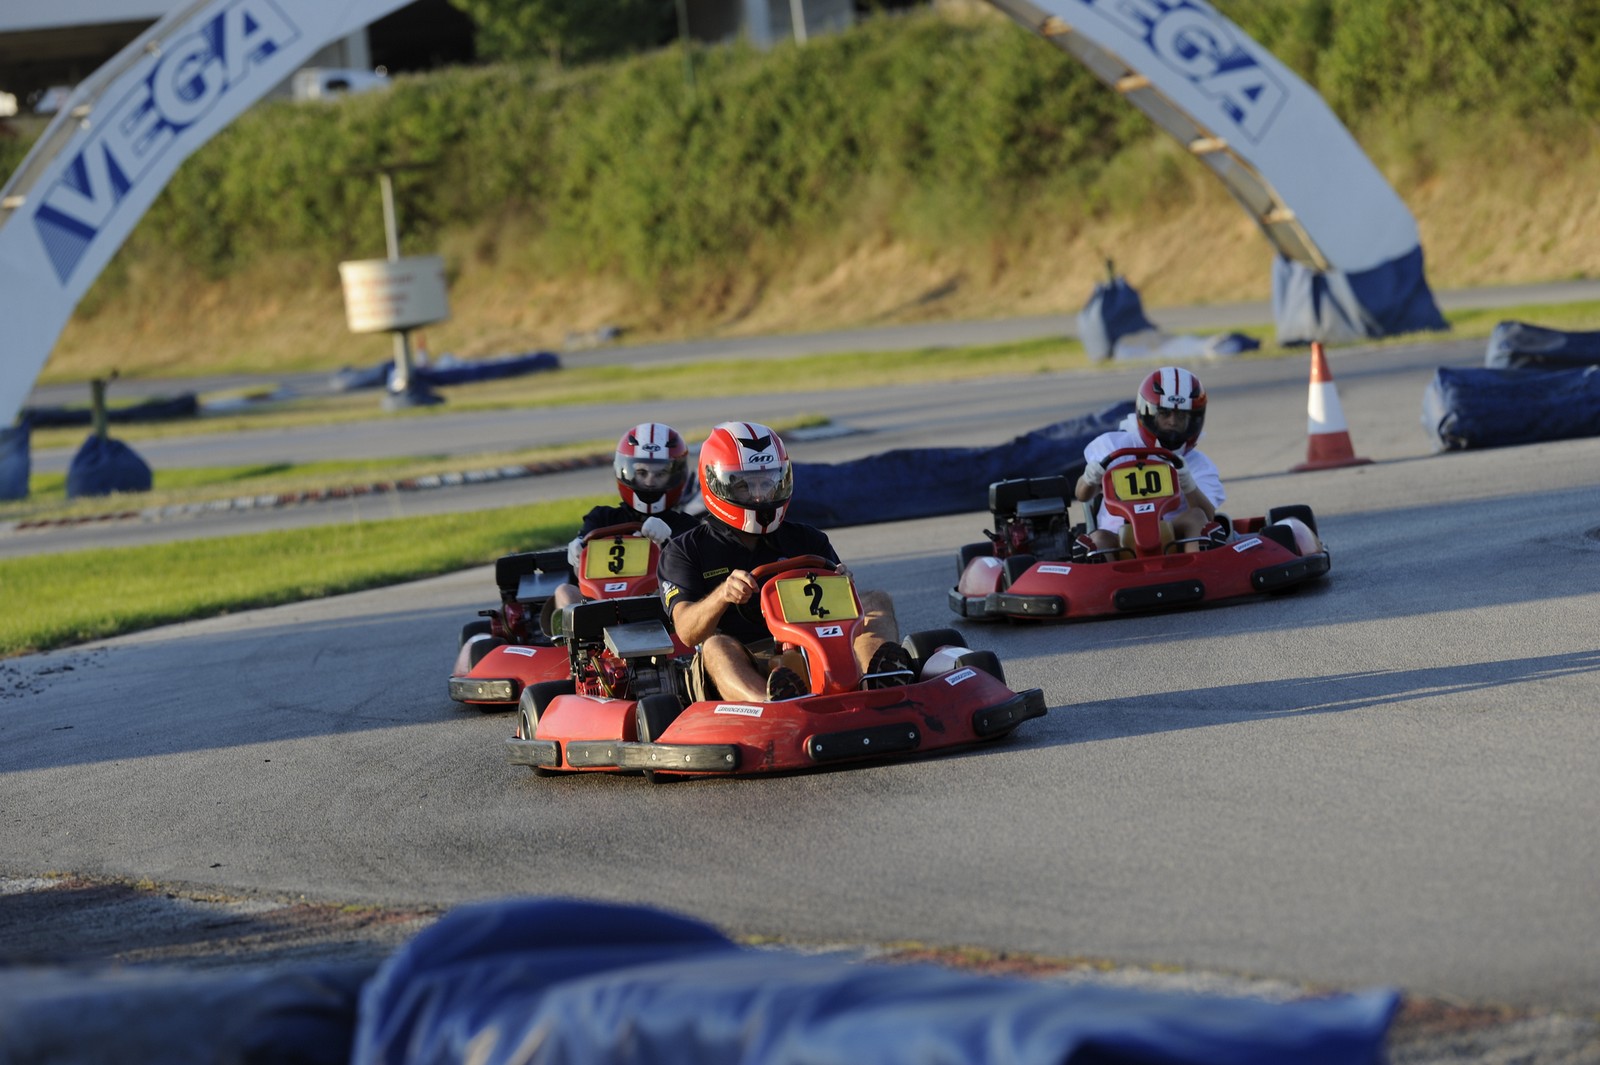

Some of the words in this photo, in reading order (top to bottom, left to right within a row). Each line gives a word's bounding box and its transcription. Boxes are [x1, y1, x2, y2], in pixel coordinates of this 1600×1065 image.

[38, 0, 299, 238] VEGA
[749, 454, 774, 464] MT
[608, 545, 625, 573] 3
[804, 583, 830, 617] 2
